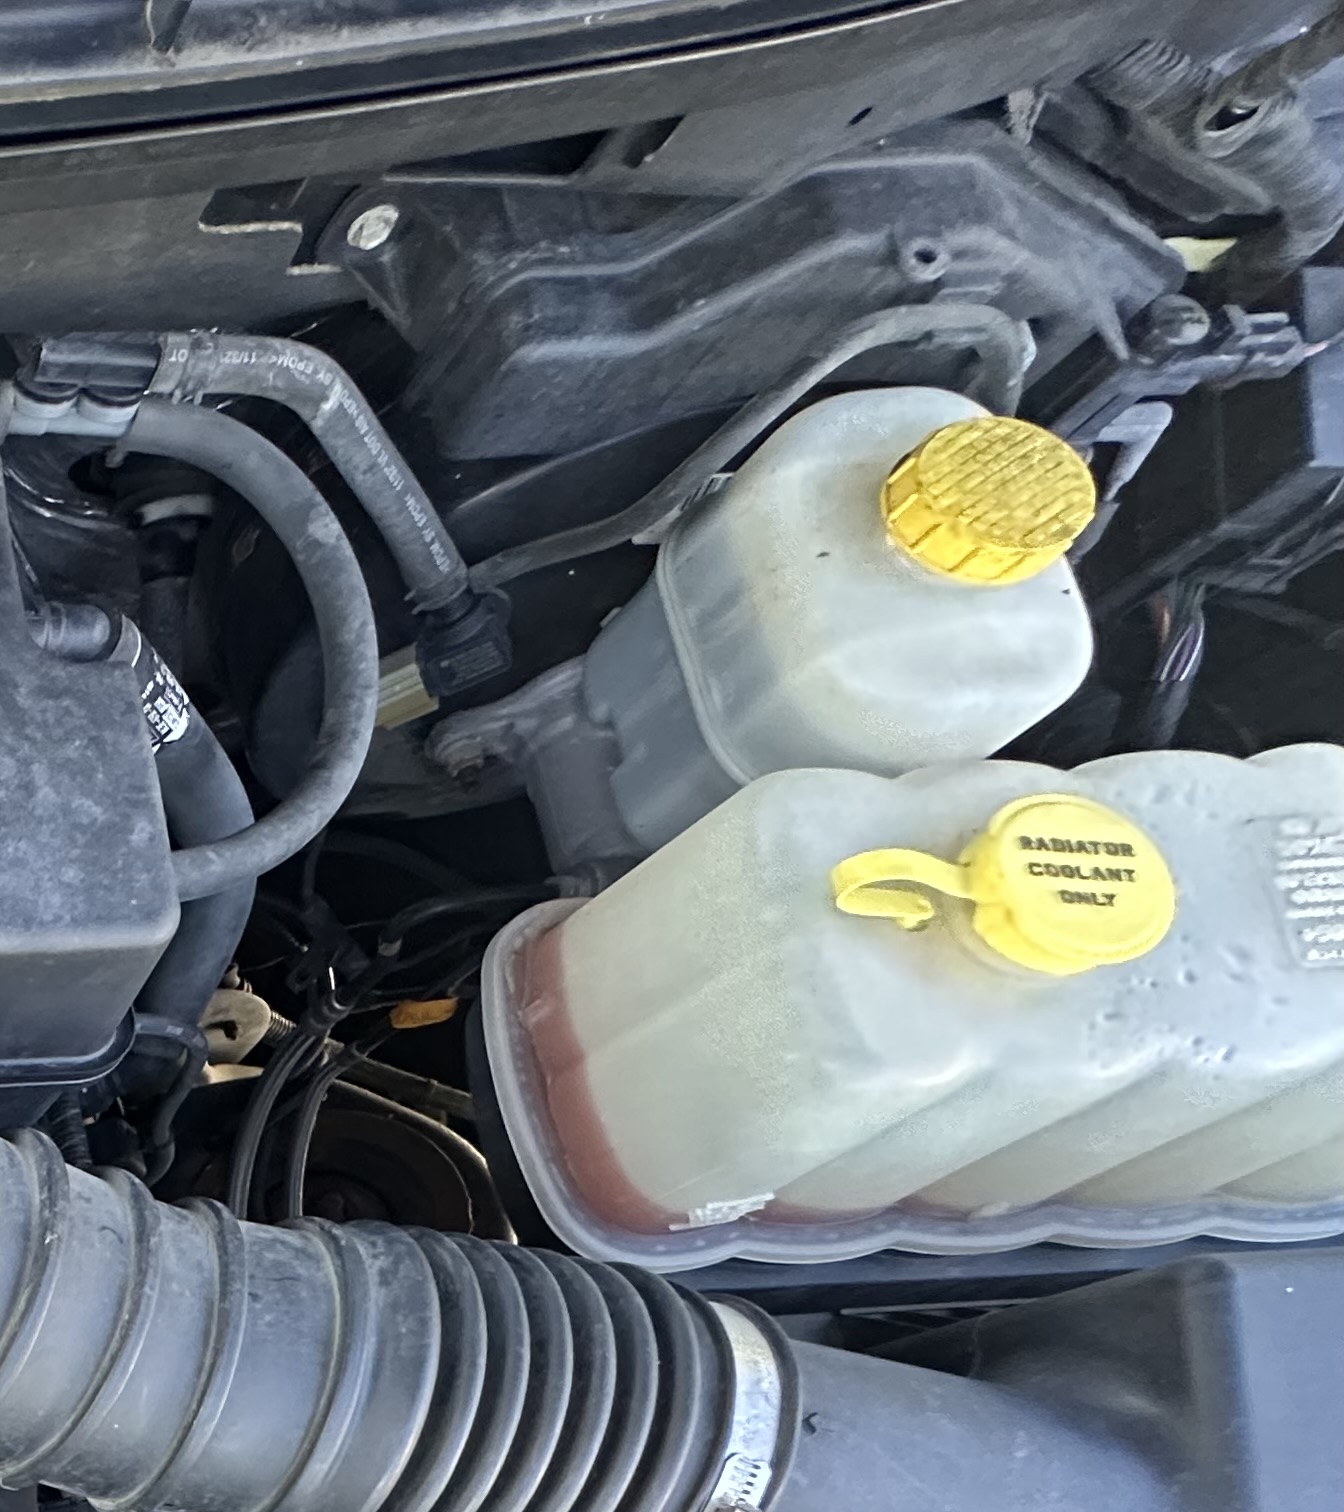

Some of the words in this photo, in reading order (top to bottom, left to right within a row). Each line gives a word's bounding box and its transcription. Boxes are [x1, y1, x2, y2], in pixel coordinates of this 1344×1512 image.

[1018, 833, 1136, 858] RADIATOR
[1027, 861, 1137, 885] COOLANT
[1058, 888, 1119, 909] ONLY
